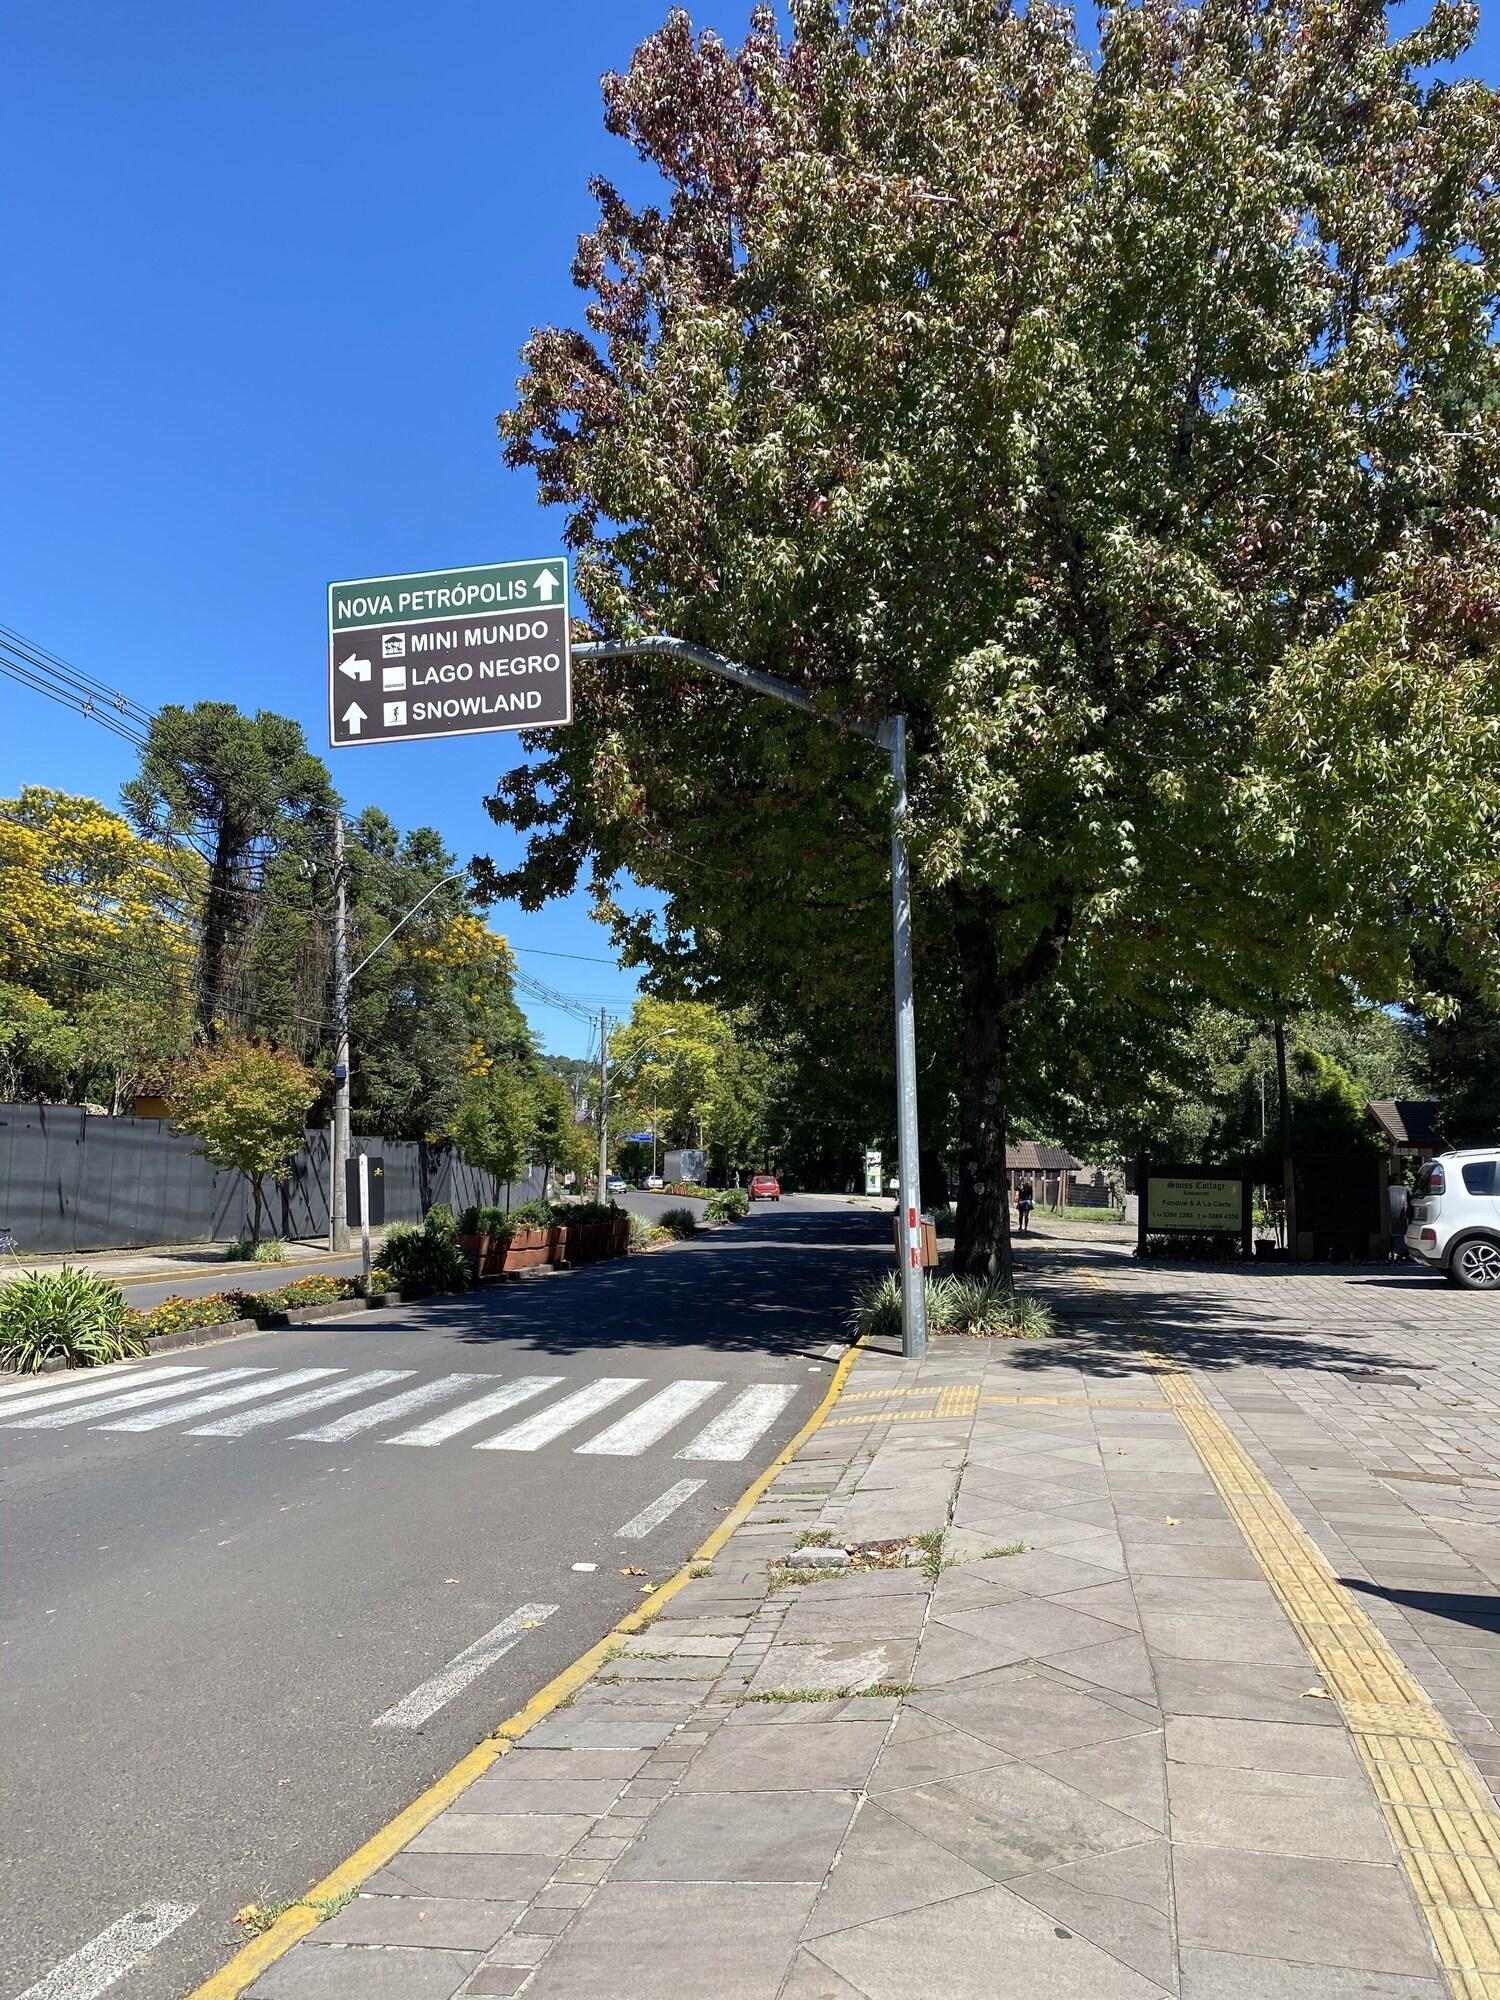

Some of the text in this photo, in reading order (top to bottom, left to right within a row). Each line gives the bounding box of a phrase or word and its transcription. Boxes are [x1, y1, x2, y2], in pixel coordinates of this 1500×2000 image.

[338, 580, 528, 620] NOVA PETRÓPOLIS
[411, 620, 549, 653] MINI MUNDO
[412, 653, 560, 686] LAGO NEGRO
[412, 691, 542, 722] SNOWLAND
